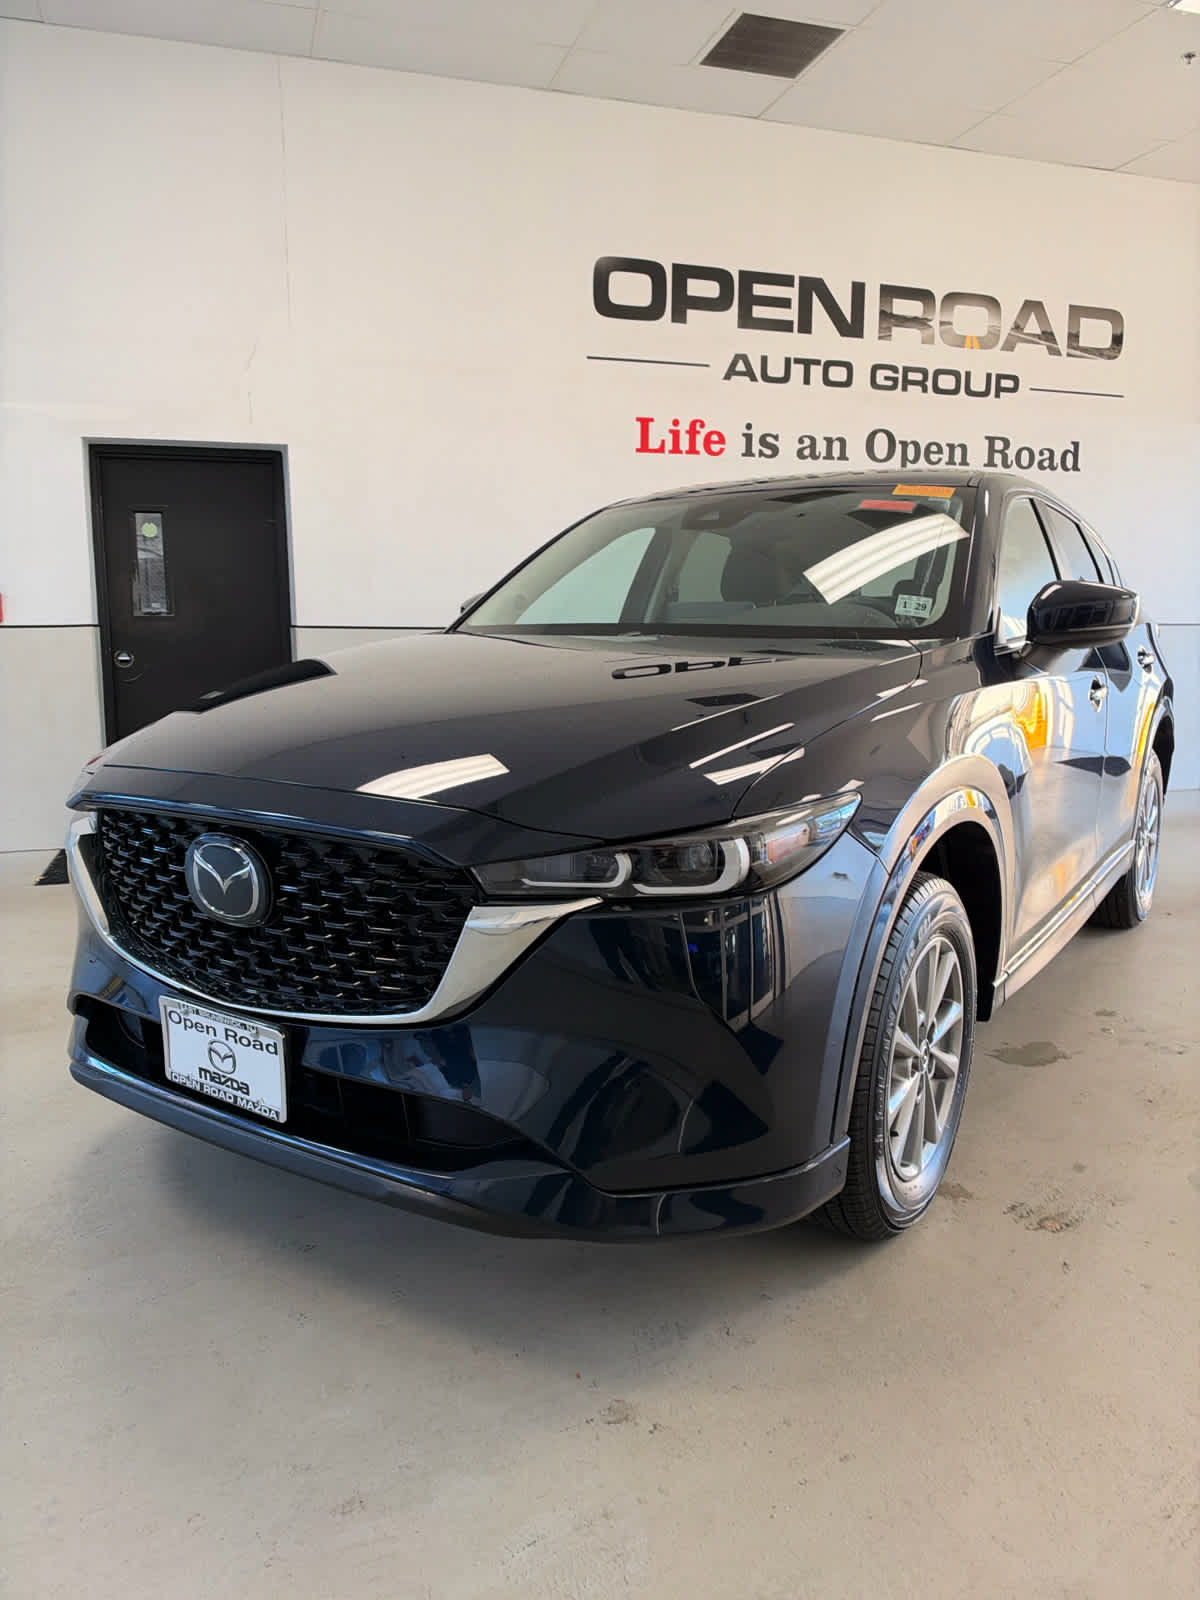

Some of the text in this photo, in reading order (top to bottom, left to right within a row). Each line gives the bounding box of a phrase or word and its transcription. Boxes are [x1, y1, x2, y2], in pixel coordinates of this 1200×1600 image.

[722, 353, 1020, 399] AUTO GROUP
[635, 416, 1081, 472] Life is an Open Road
[913, 602, 927, 611] 29
[168, 1010, 217, 1037] Open
[224, 1027, 279, 1056] Road
[203, 1084, 234, 1104] ROAD
[237, 1096, 280, 1121] MAZDA
